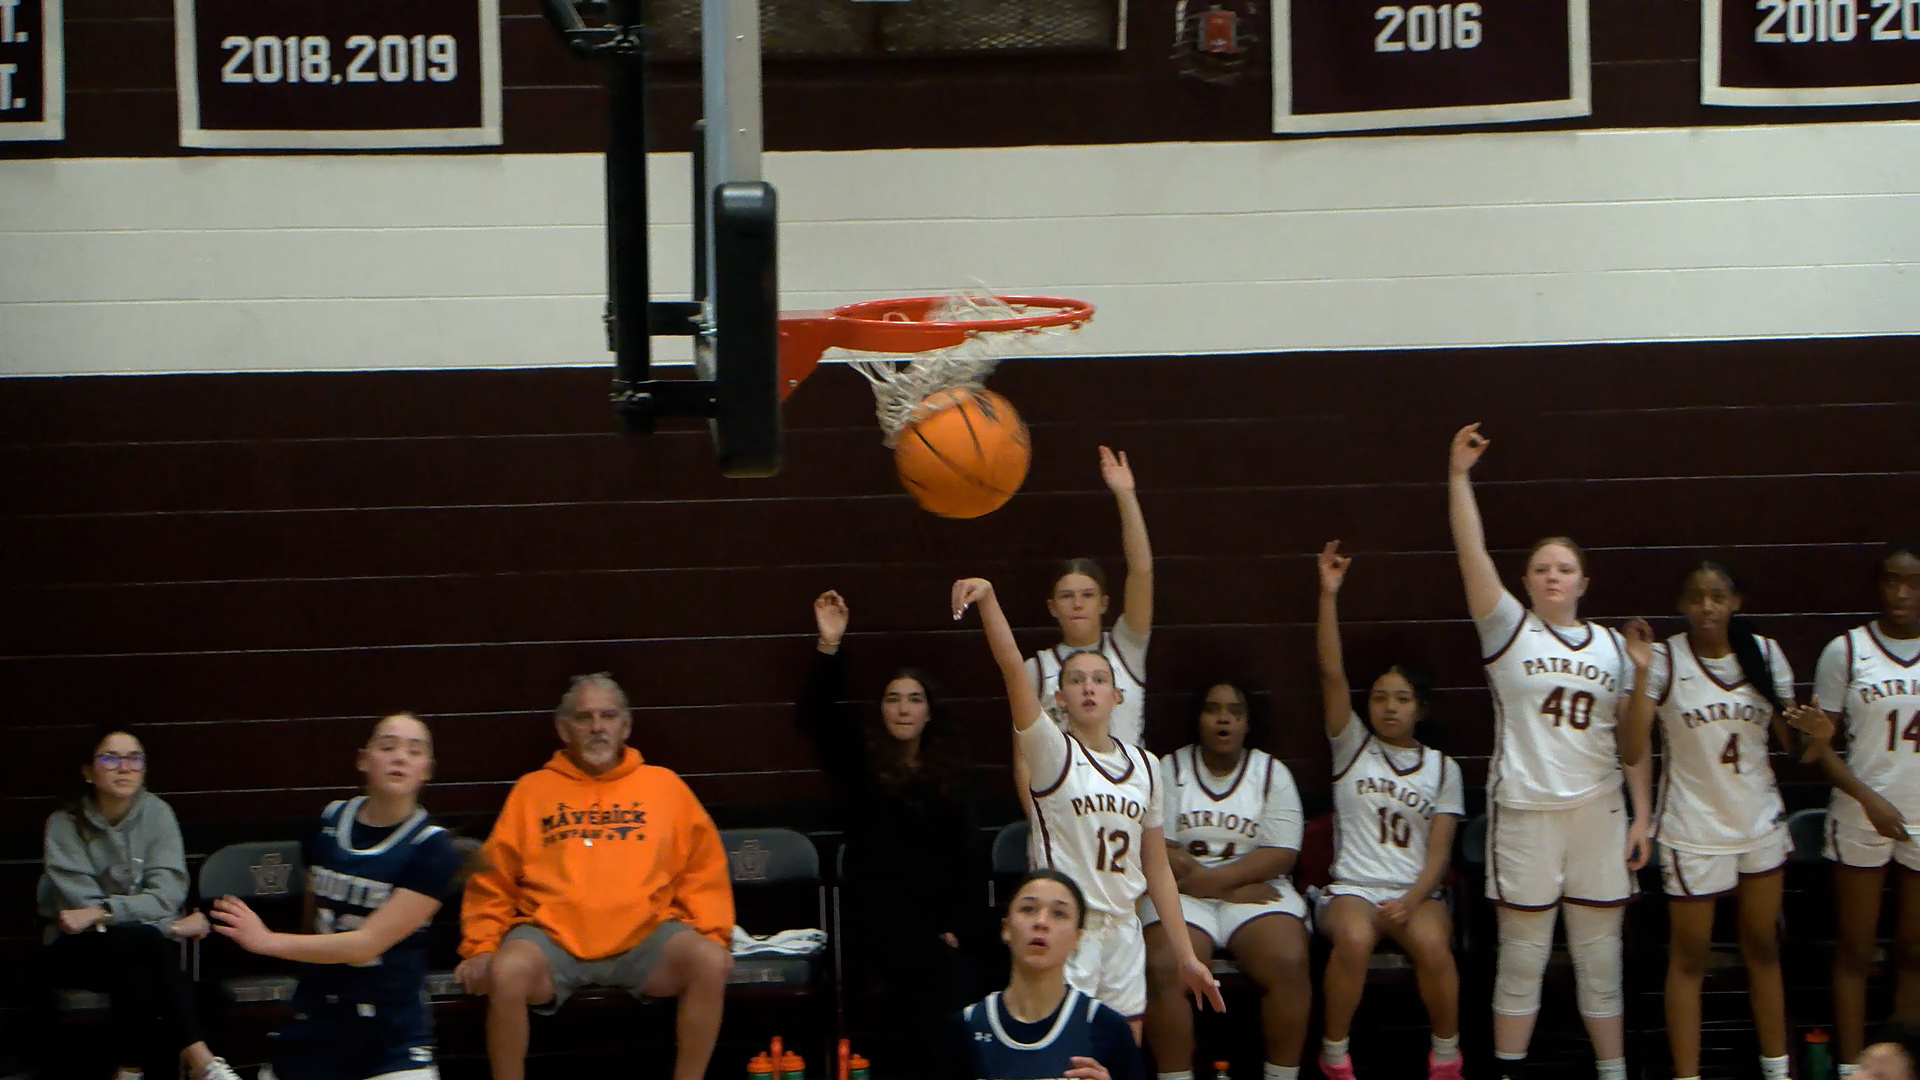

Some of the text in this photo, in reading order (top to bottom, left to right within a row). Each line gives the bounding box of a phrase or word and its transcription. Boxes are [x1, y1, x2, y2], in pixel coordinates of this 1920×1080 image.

[1374, 2, 1482, 52] 2016
[220, 34, 458, 85] 2018,2019
[1522, 656, 1617, 693] PATRIOTS
[1858, 678, 1920, 705] PATRI
[1541, 684, 1595, 731] 40
[1719, 732, 1740, 774] 4
[1886, 708, 1920, 753] 14
[1095, 825, 1131, 874] 12
[1378, 805, 1412, 849] 10
